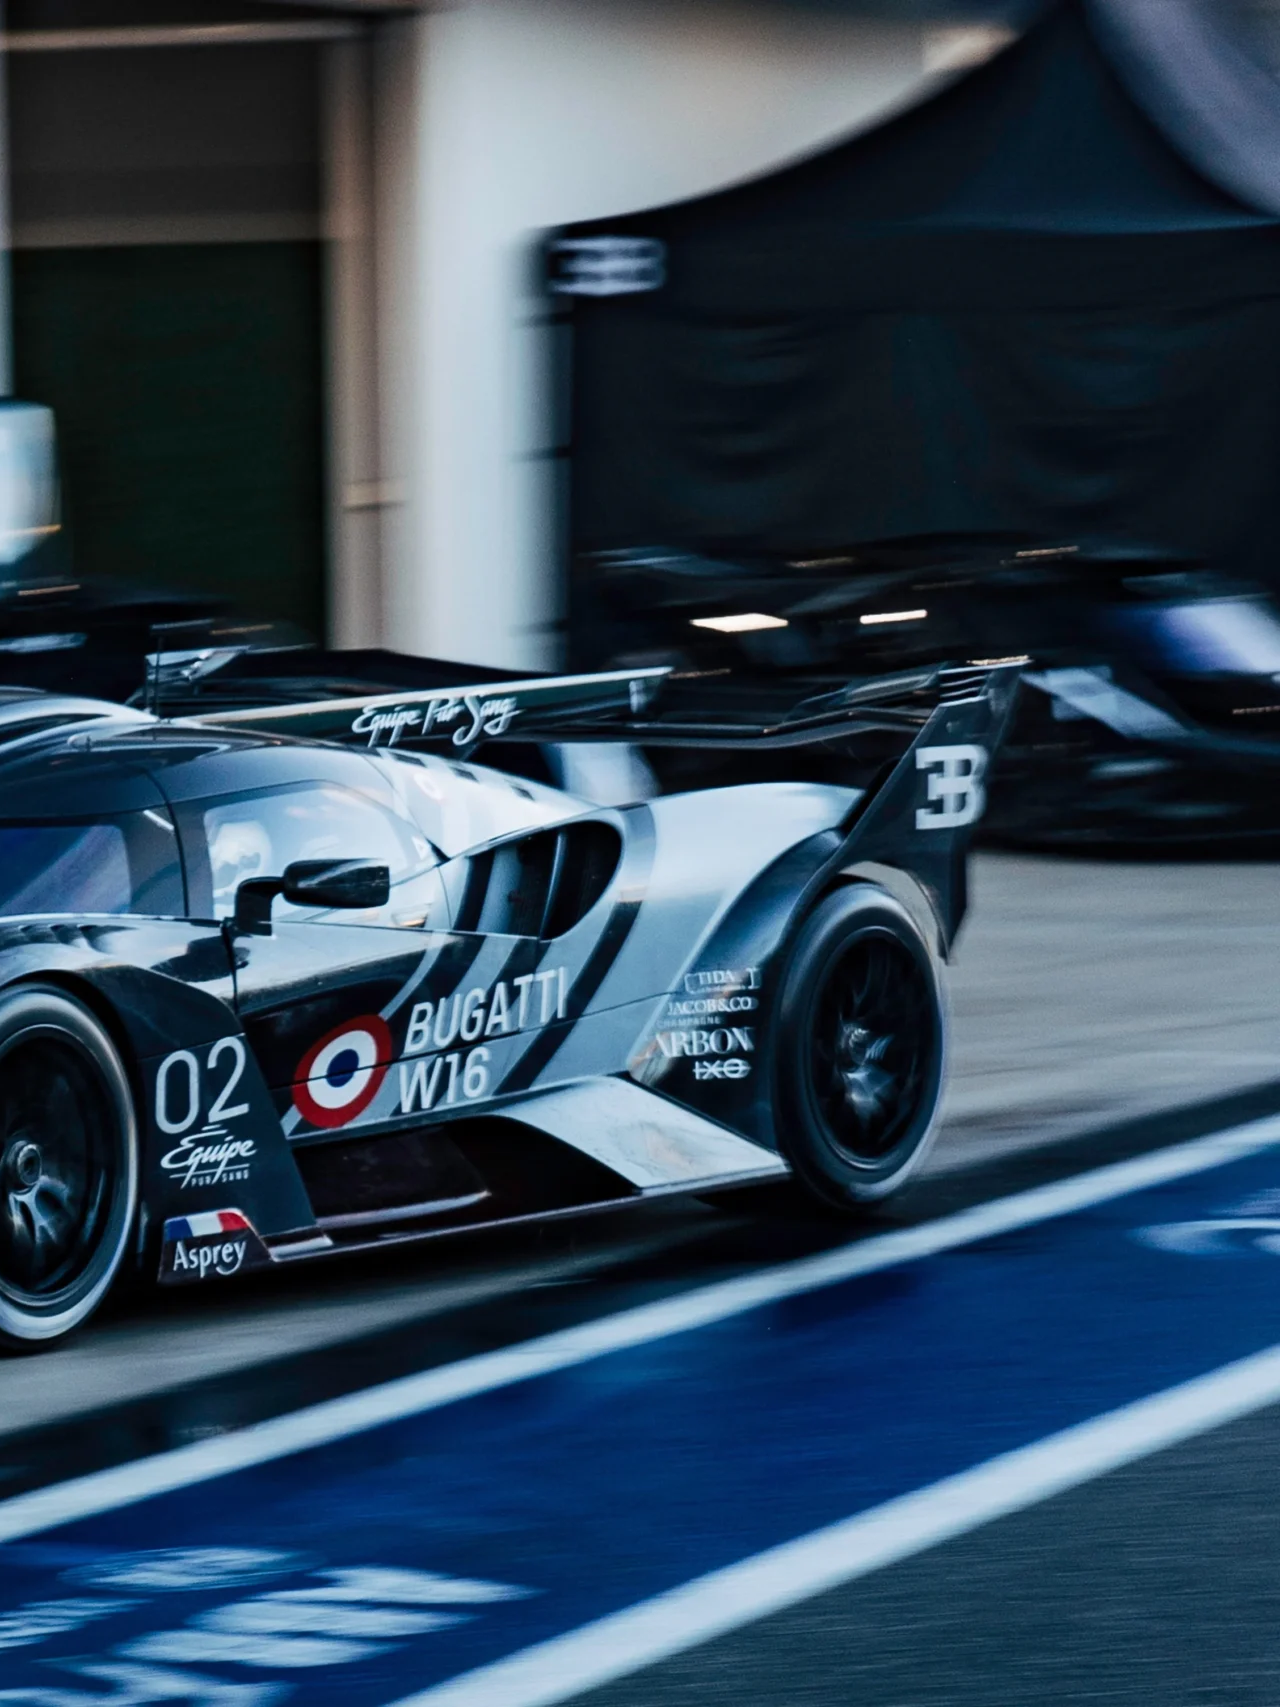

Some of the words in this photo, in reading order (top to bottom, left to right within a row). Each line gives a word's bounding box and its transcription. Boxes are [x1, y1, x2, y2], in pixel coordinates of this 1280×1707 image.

[403, 966, 568, 1054] BUGATTI
[655, 1026, 755, 1058] ARBON
[155, 1036, 249, 1134] 02
[399, 1046, 490, 1113] W16
[172, 1240, 247, 1278] Asprey
